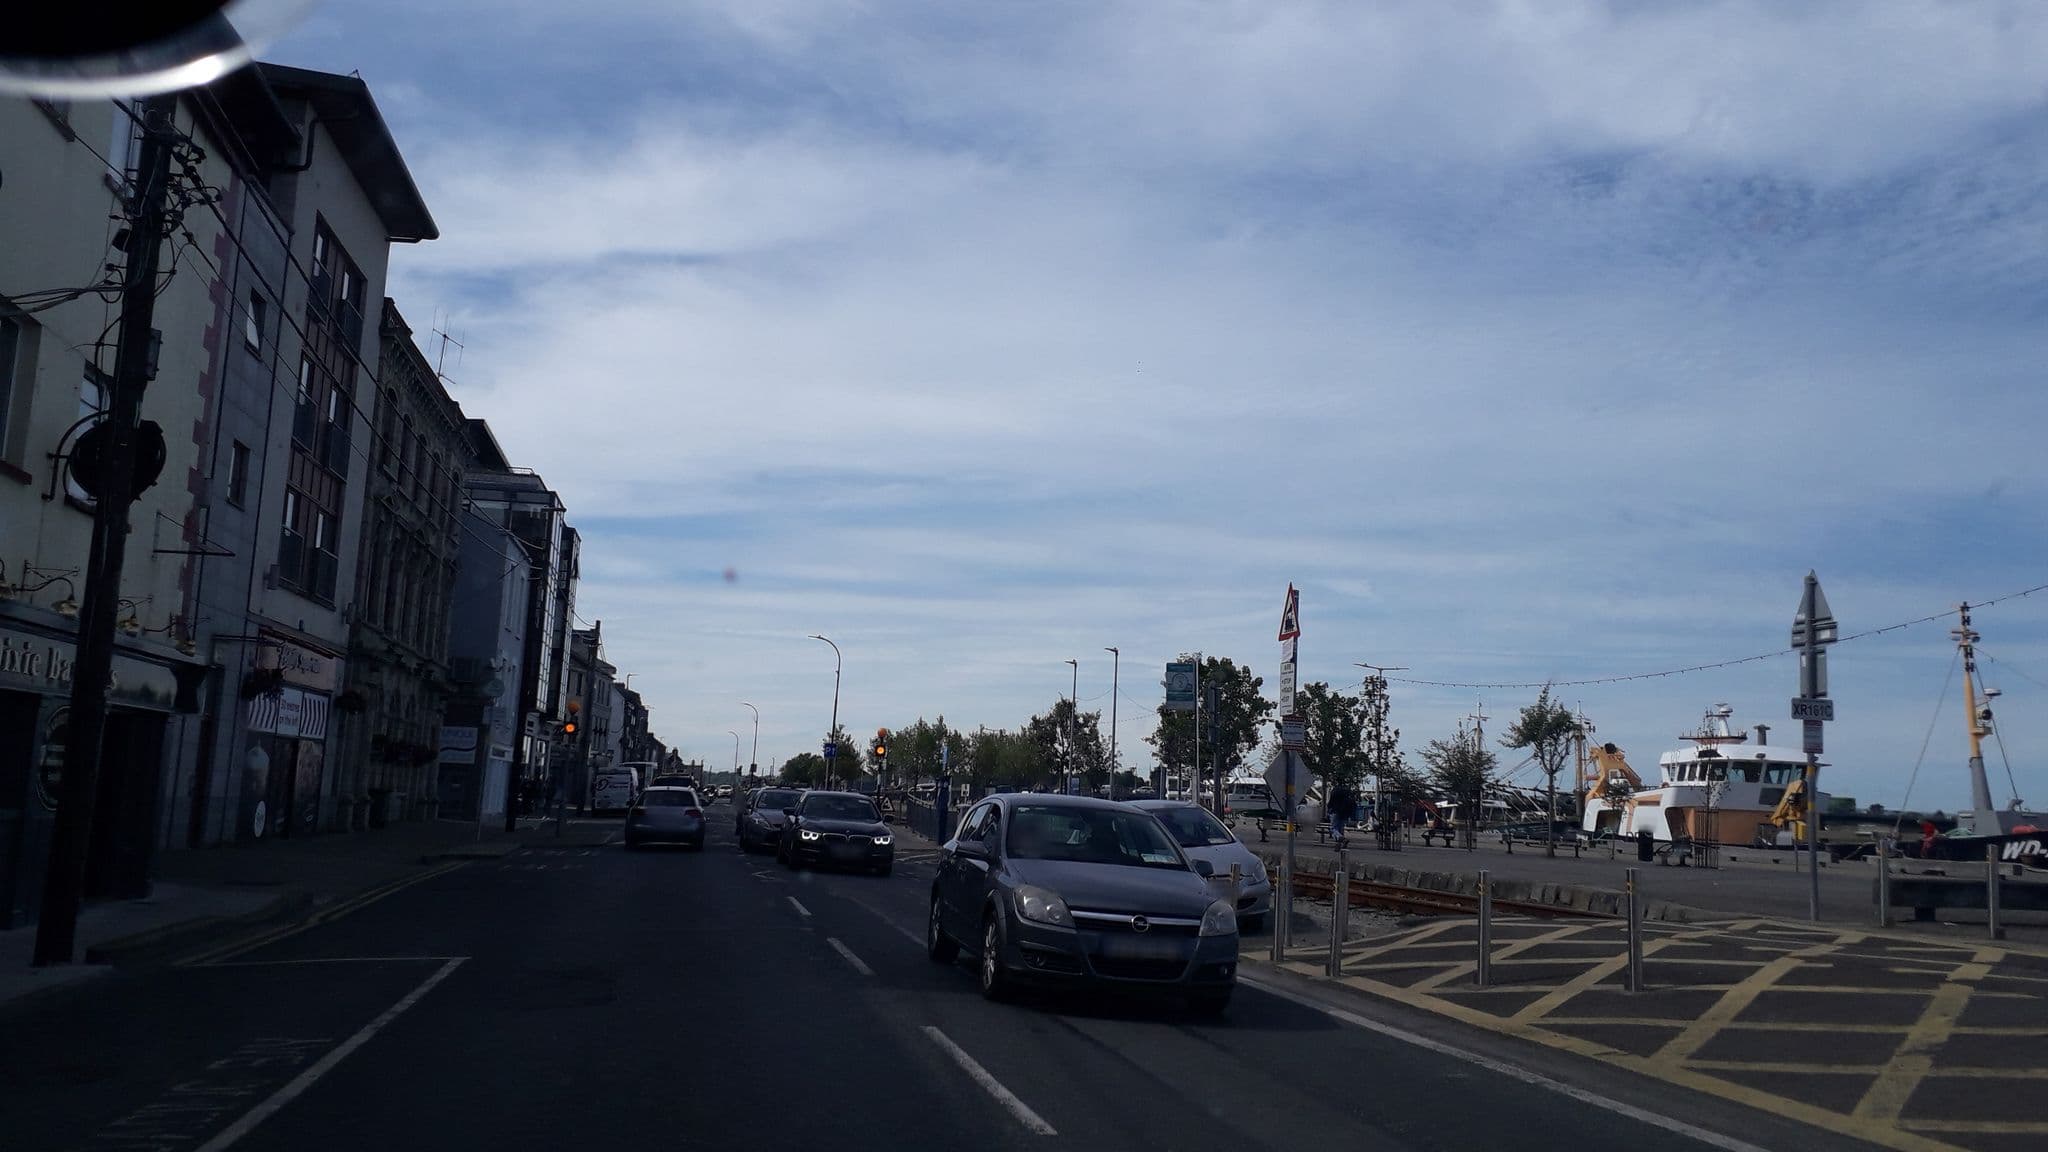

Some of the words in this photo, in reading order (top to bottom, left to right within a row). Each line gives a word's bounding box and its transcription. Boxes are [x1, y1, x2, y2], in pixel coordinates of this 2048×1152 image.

[0, 638, 41, 677] ixie
[1793, 703, 1832, 717] XR161C
[2002, 840, 2048, 859] WD-
